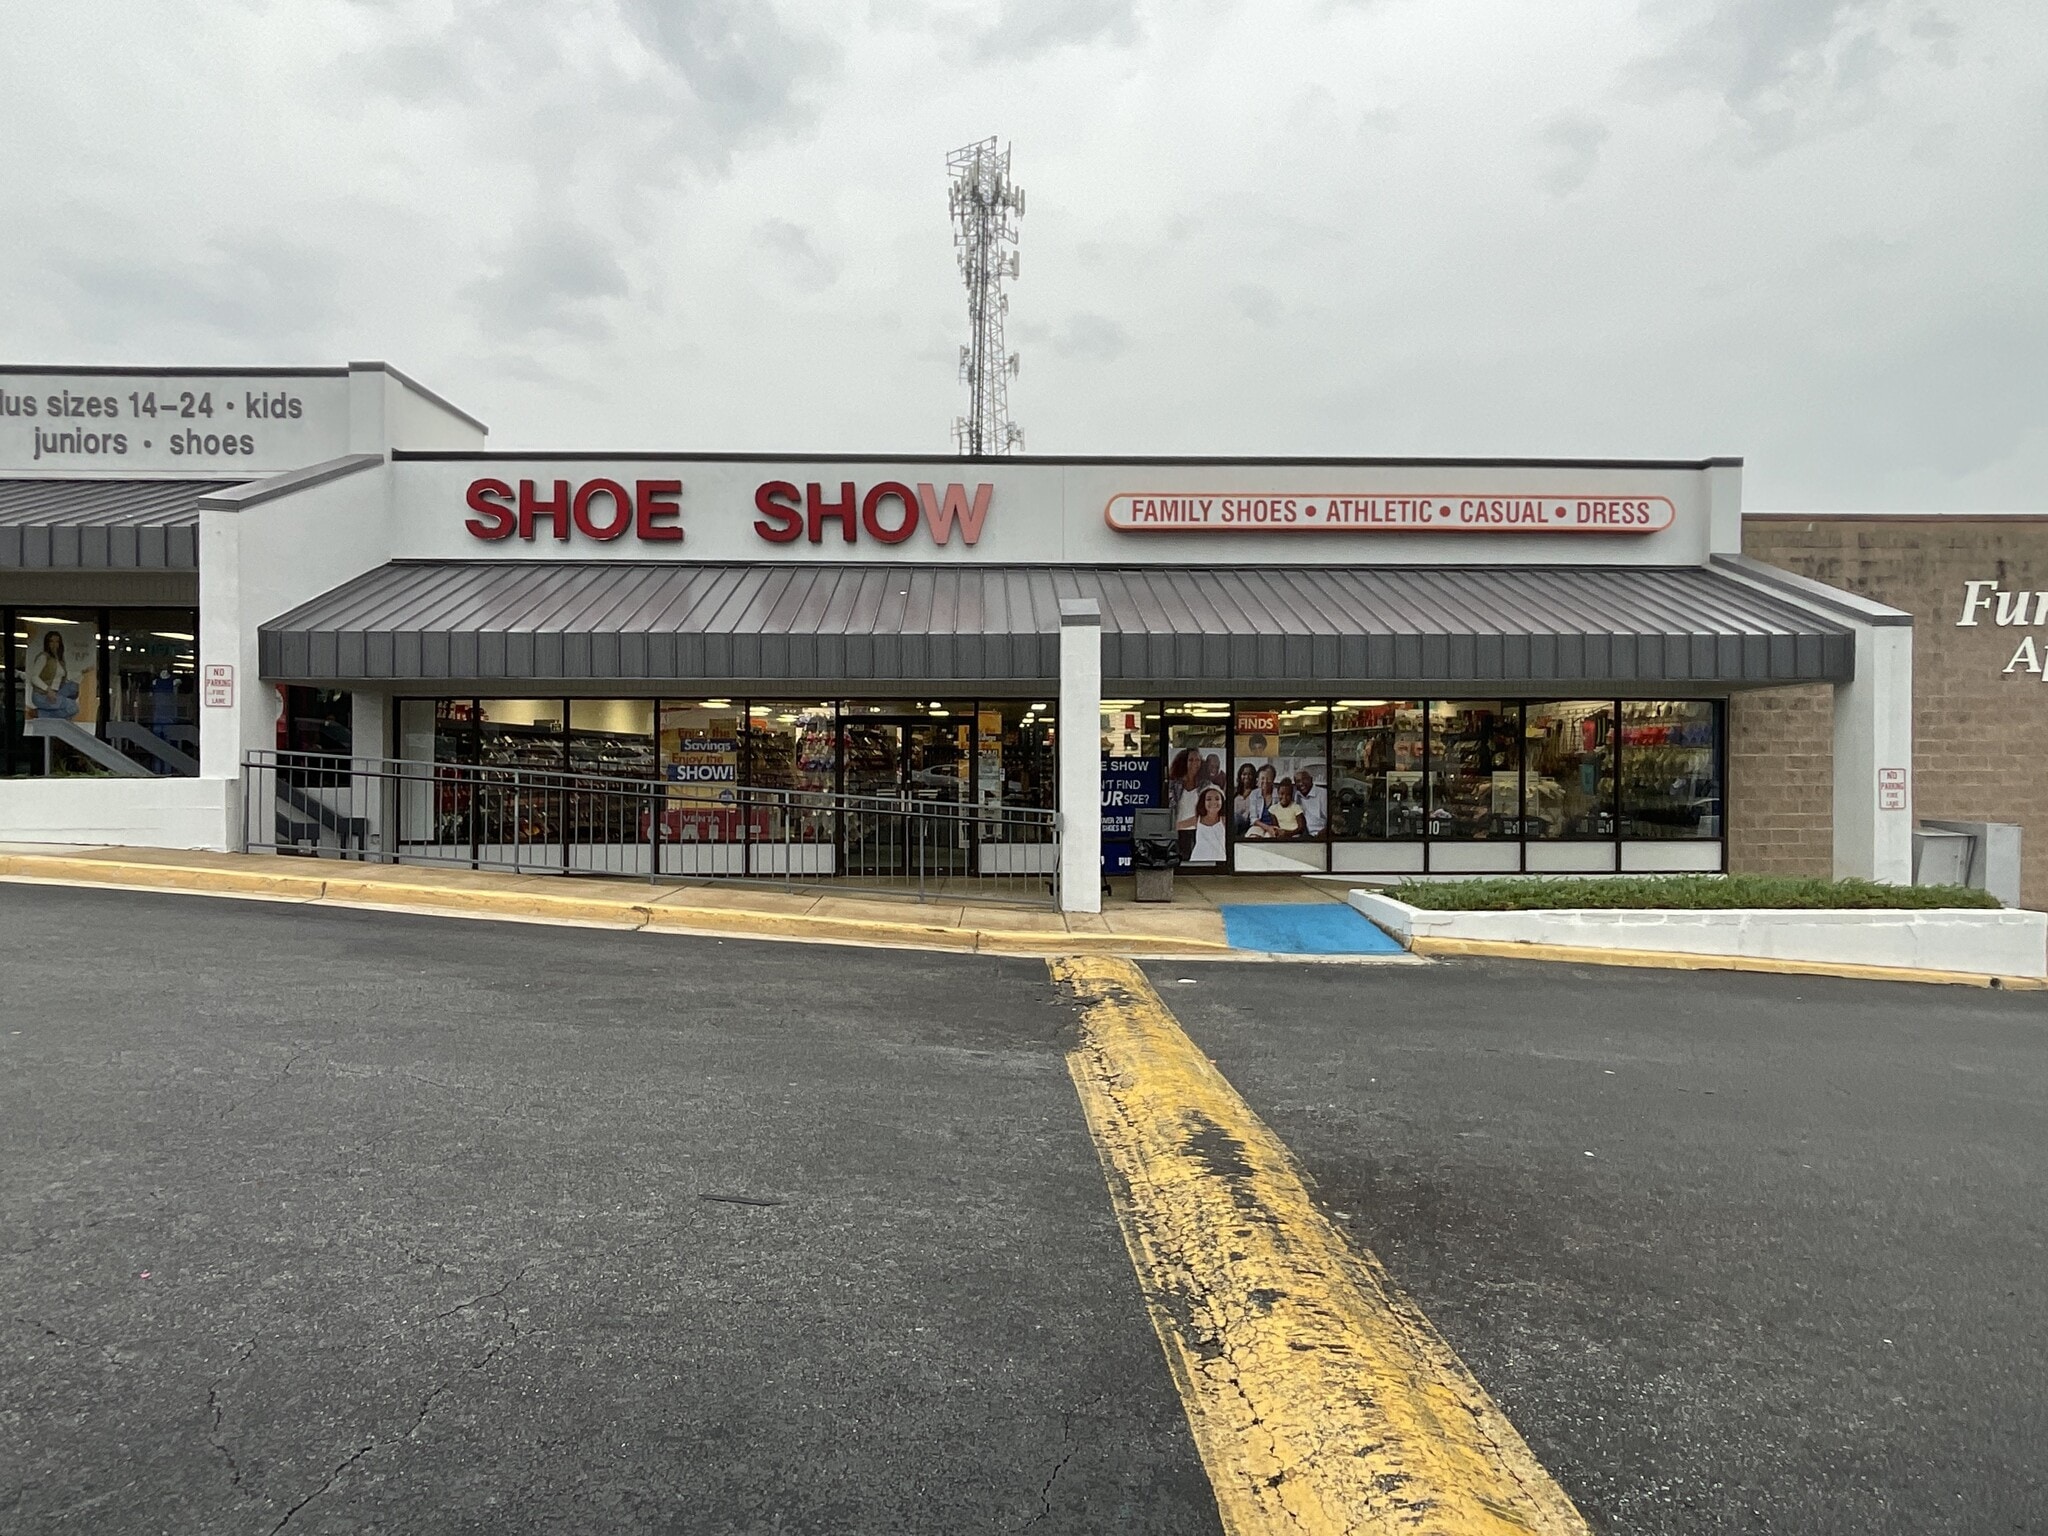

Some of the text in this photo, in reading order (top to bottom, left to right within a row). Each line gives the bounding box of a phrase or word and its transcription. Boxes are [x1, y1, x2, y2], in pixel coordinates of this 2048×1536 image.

[46, 389, 119, 418] sizes
[245, 391, 303, 419] kids
[33, 426, 255, 460] juniors shoes
[465, 478, 994, 545] SHOE SHOW
[1131, 499, 1650, 525] FAMILY SHOES ATHLETIC CASUAL DRESS
[2002, 635, 2048, 682] A
[213, 668, 225, 676] NO
[205, 679, 231, 687] PARKING
[1237, 718, 1275, 730] FINDS
[684, 739, 731, 752] Savings
[671, 752, 724, 764] Enjoy the
[676, 765, 734, 780] SHOW!
[1110, 761, 1150, 772] SHOW
[1886, 771, 1898, 780] NO
[1116, 779, 1141, 790] FIND
[1124, 794, 1149, 804] SIZE?
[682, 815, 719, 823] VENTA
